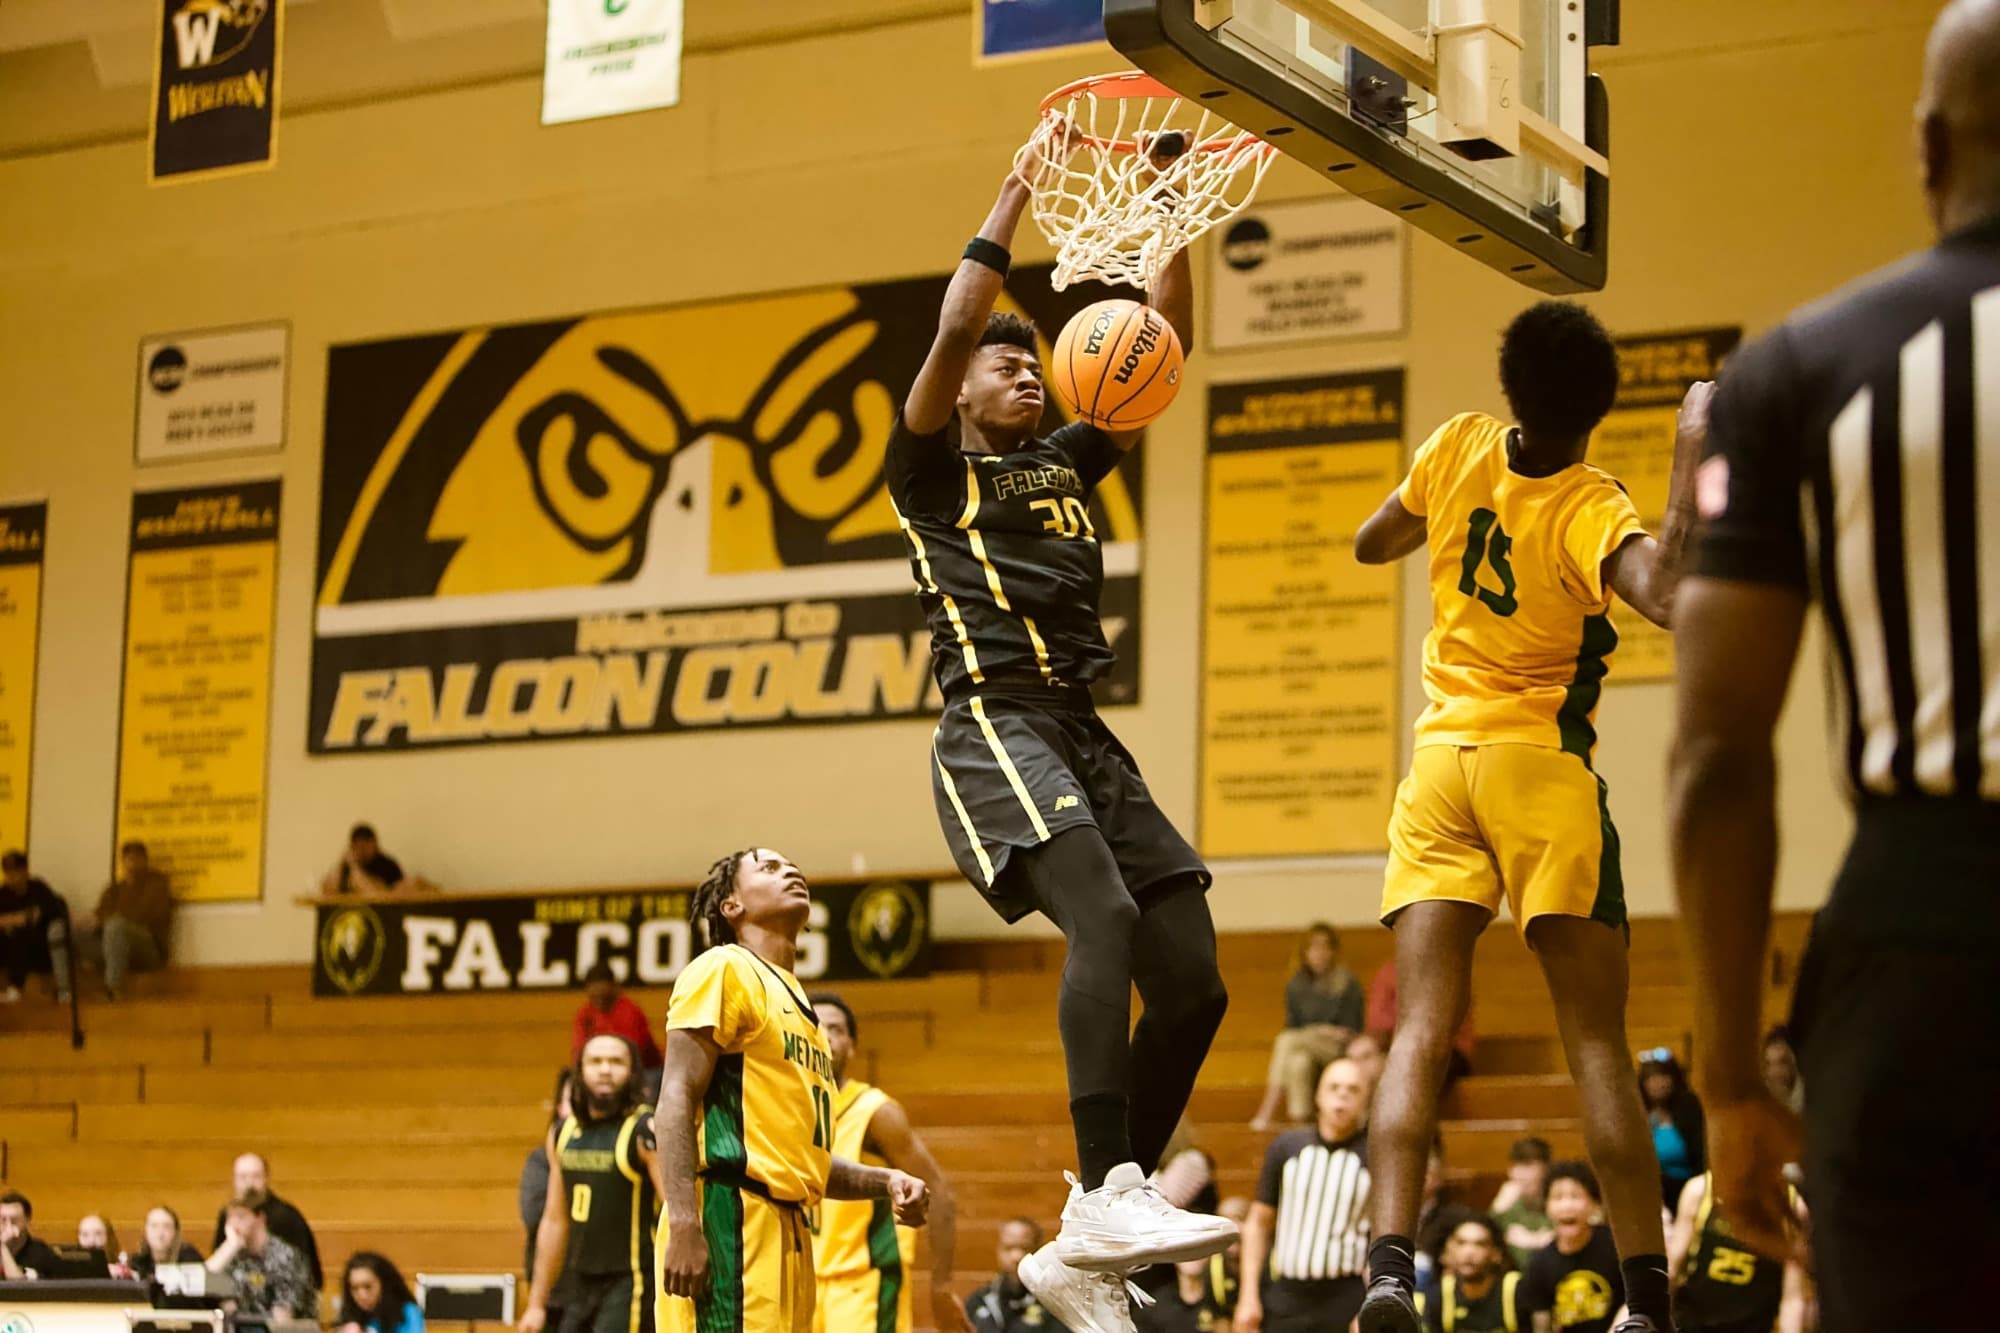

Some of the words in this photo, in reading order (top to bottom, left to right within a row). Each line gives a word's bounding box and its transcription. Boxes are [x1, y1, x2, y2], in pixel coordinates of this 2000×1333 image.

[1084, 307, 1118, 356] NCAA
[1112, 312, 1163, 385] Wilson
[1029, 497, 1096, 543] 30
[1458, 507, 1518, 617] 15
[576, 607, 780, 654] Welcome
[784, 600, 842, 640] to
[323, 651, 670, 749] FALCON
[401, 901, 829, 990] FALCOS
[571, 1183, 592, 1223] 0
